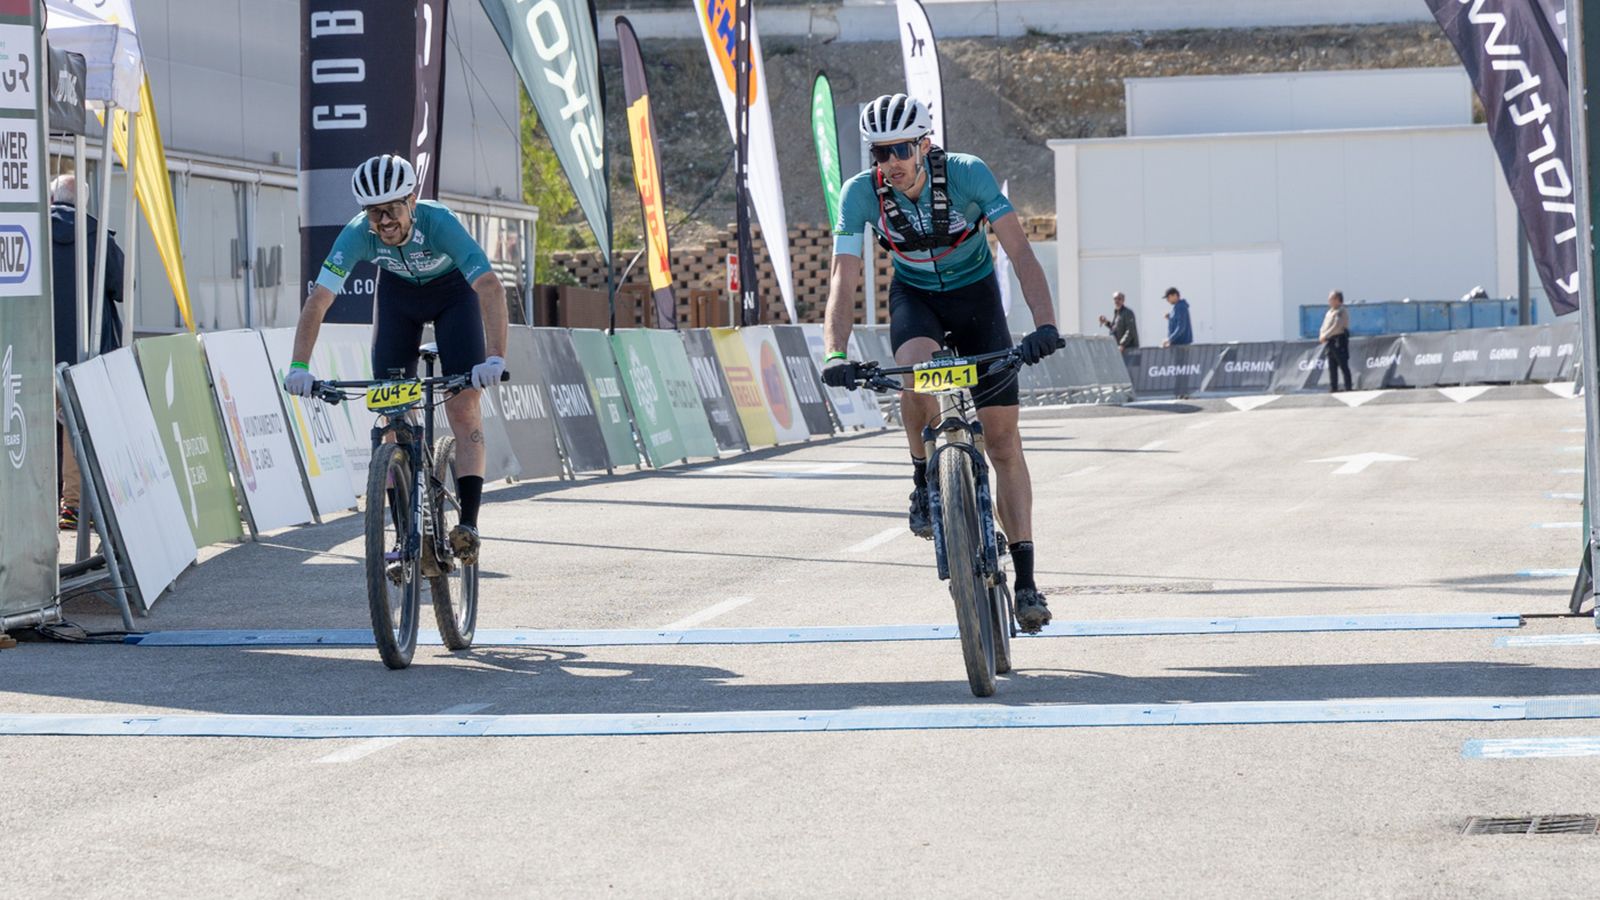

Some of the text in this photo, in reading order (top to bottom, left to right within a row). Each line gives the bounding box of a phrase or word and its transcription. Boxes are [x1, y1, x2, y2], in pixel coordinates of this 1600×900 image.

[2, 161, 28, 189] ADE
[1148, 364, 1201, 377] GARMIN
[1224, 360, 1275, 373] GARMIN
[1298, 359, 1329, 371] GAR
[919, 368, 971, 389] 204-1
[371, 382, 418, 404] 204-2
[499, 384, 546, 421] GARMIN
[550, 384, 593, 417] GARMIN
